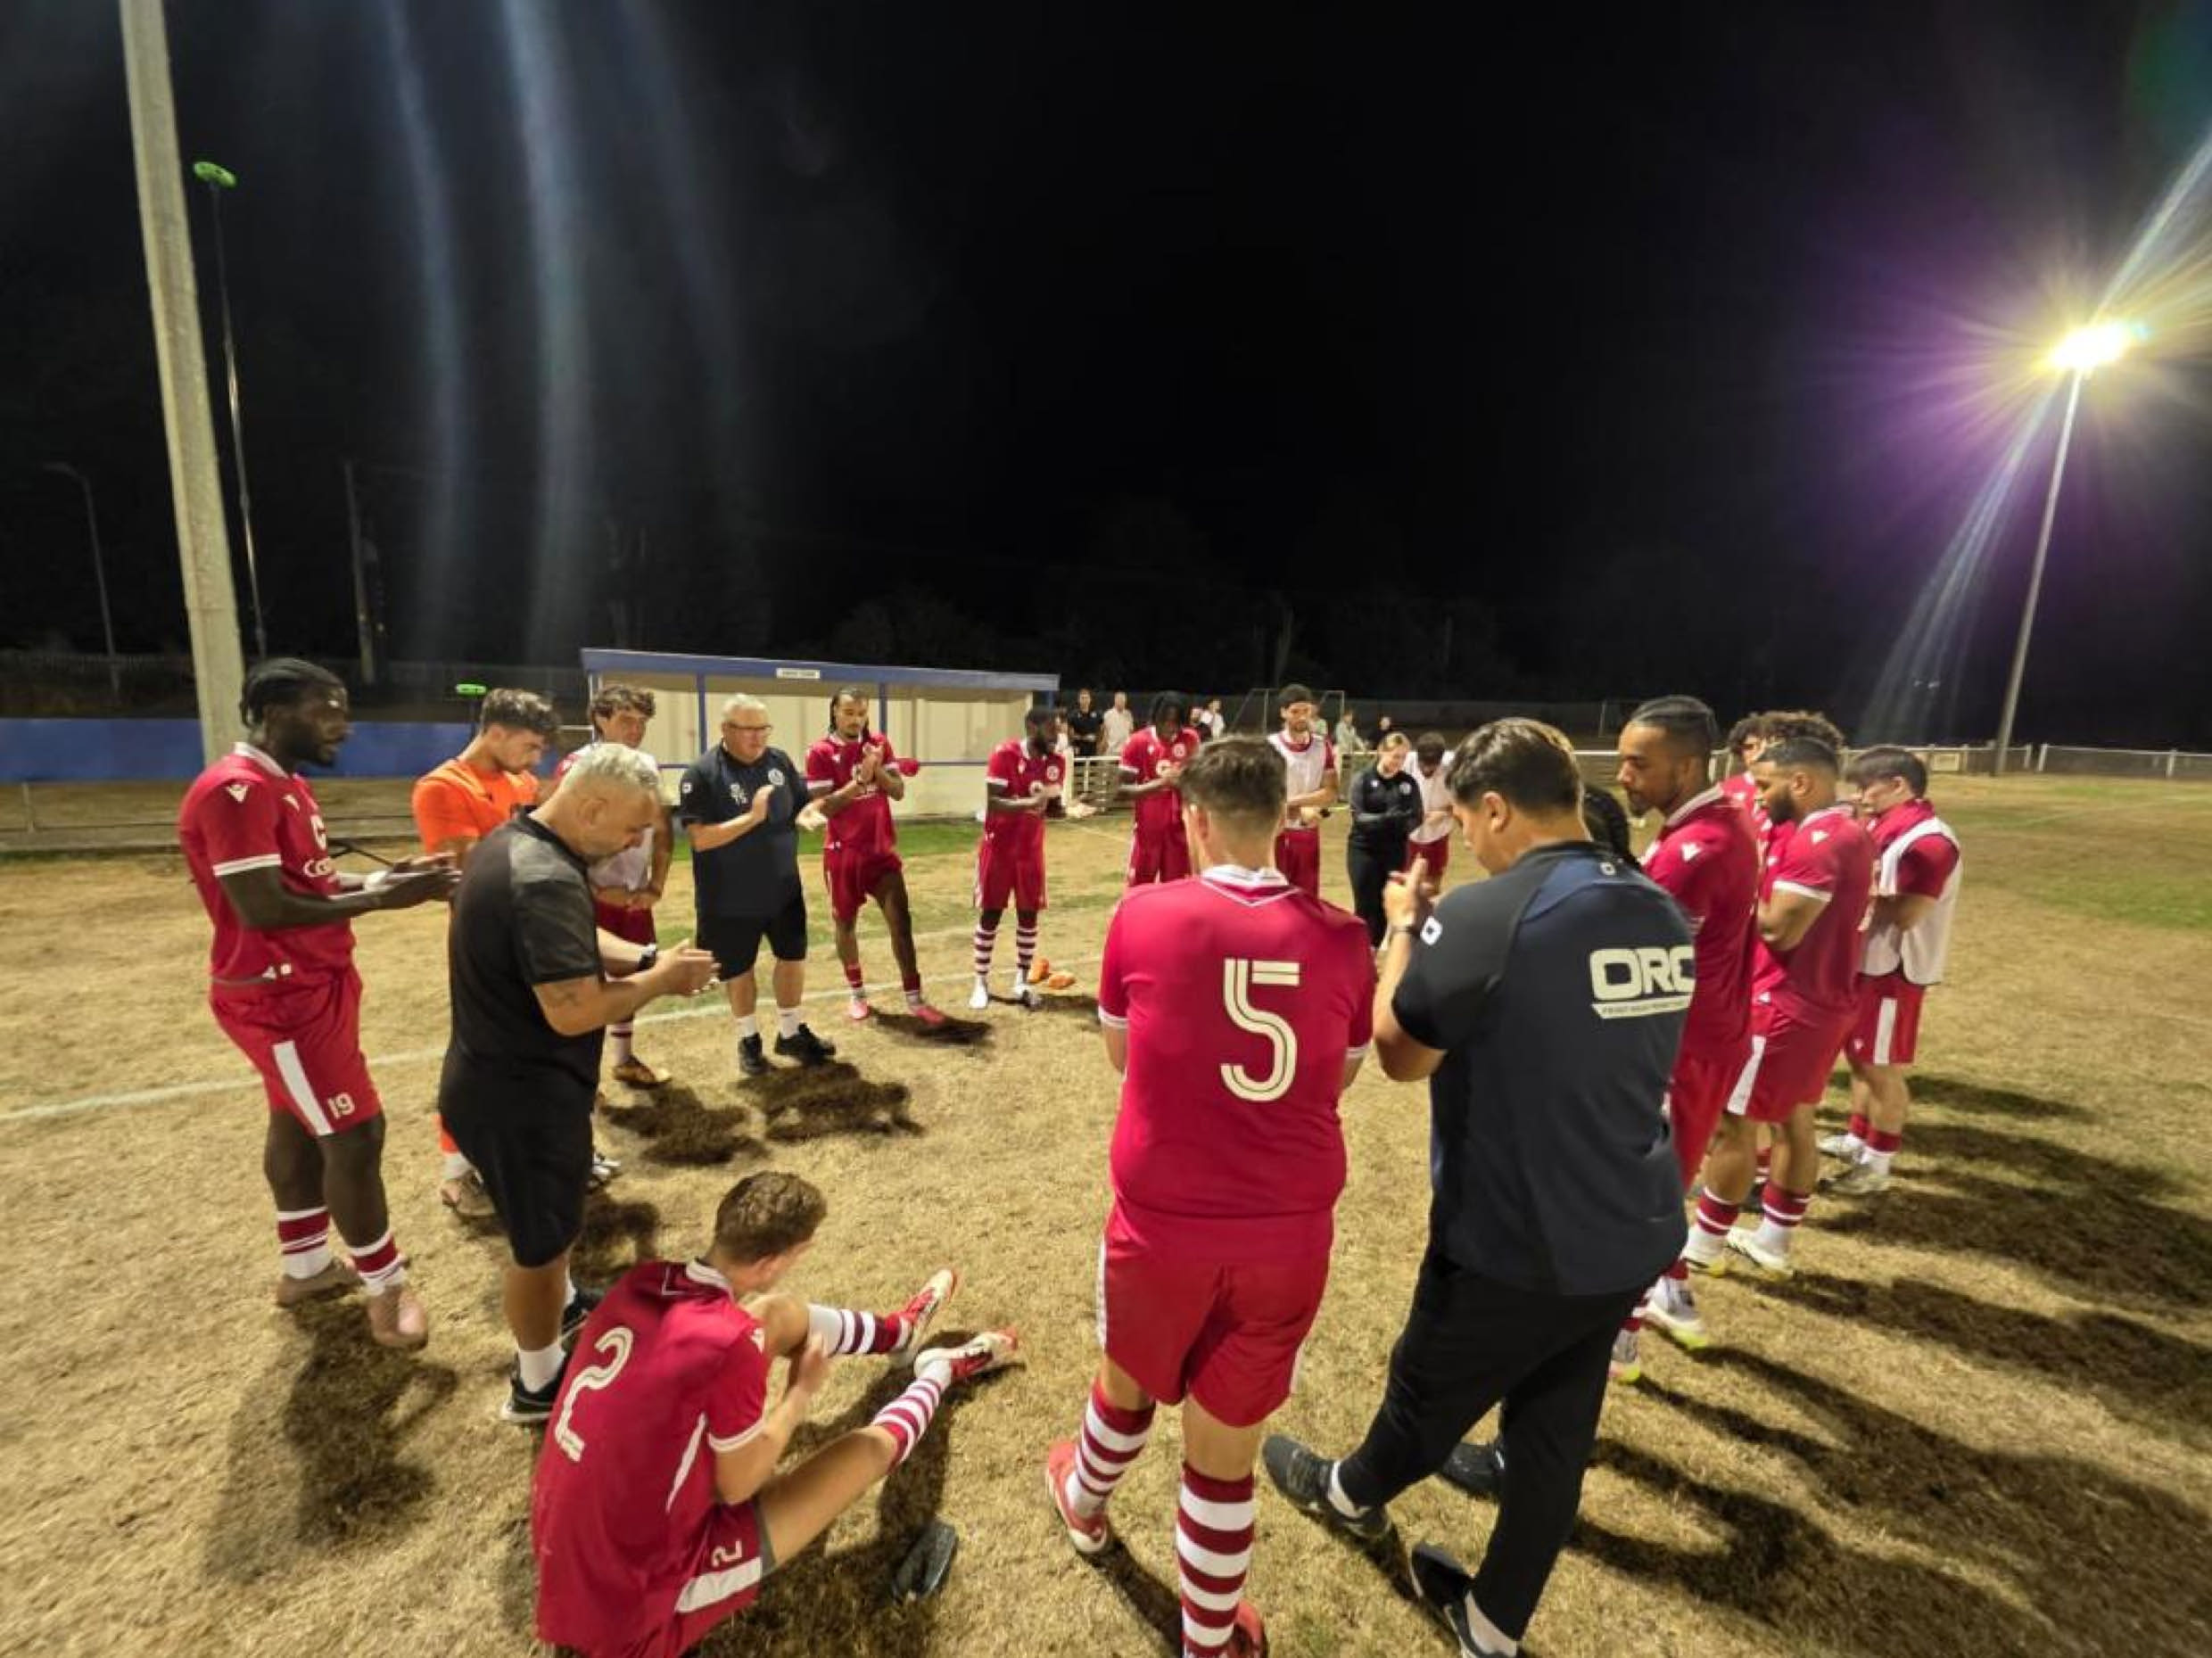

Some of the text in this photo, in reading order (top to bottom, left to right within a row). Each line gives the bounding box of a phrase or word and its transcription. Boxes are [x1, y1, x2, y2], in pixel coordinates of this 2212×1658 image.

[1220, 958, 1300, 1101] 5
[326, 1091, 355, 1120] 19
[555, 1326, 633, 1463] 2
[711, 1540, 742, 1566] 2
